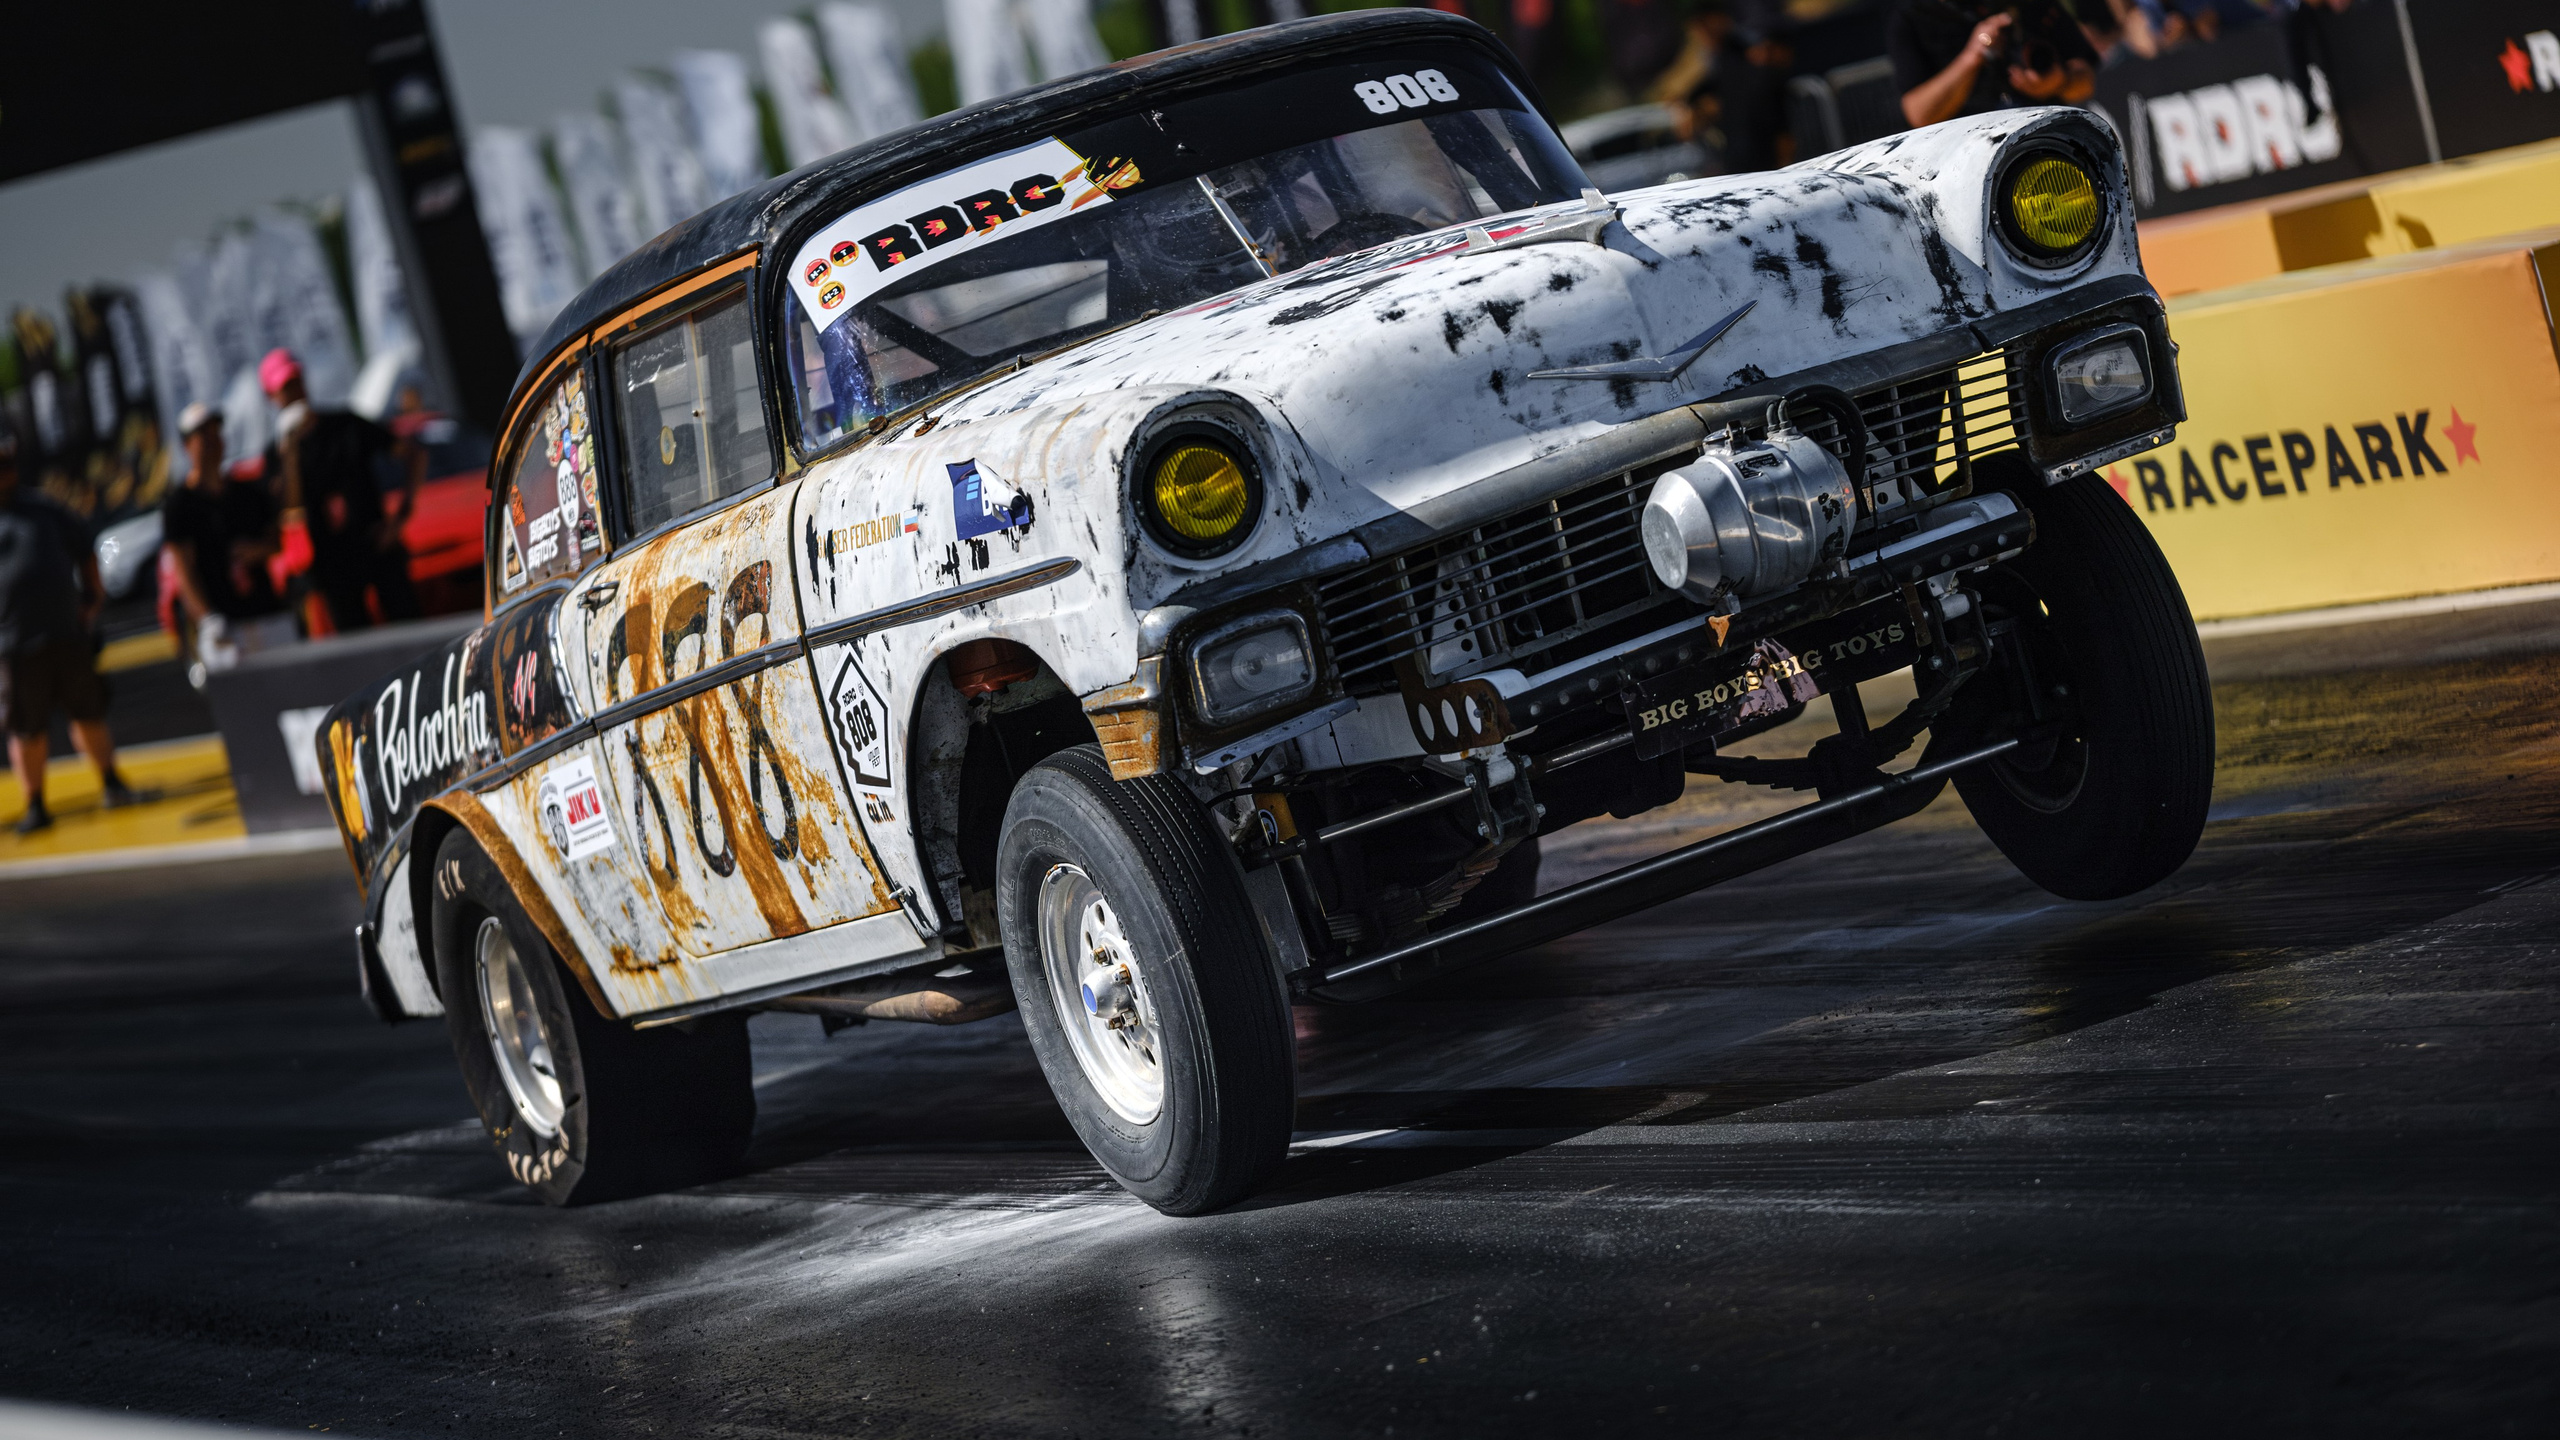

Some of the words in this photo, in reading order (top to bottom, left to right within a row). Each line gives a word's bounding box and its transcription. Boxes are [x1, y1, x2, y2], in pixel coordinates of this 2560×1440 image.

[1353, 68, 1460, 114] 808
[857, 173, 1066, 272] RDRC
[810, 265, 825, 279] M-1
[823, 288, 840, 302] M-2
[2133, 408, 2449, 514] RACEPARK
[560, 472, 577, 505] 888
[849, 512, 902, 551] FEDERATION
[1638, 699, 1689, 731] BIG
[1694, 670, 1763, 711] BOYS
[1770, 650, 1823, 682] BIG
[1829, 622, 1905, 661] TOYS
[375, 646, 490, 815] Belochka
[607, 560, 799, 888] 888
[845, 698, 877, 752] 808
